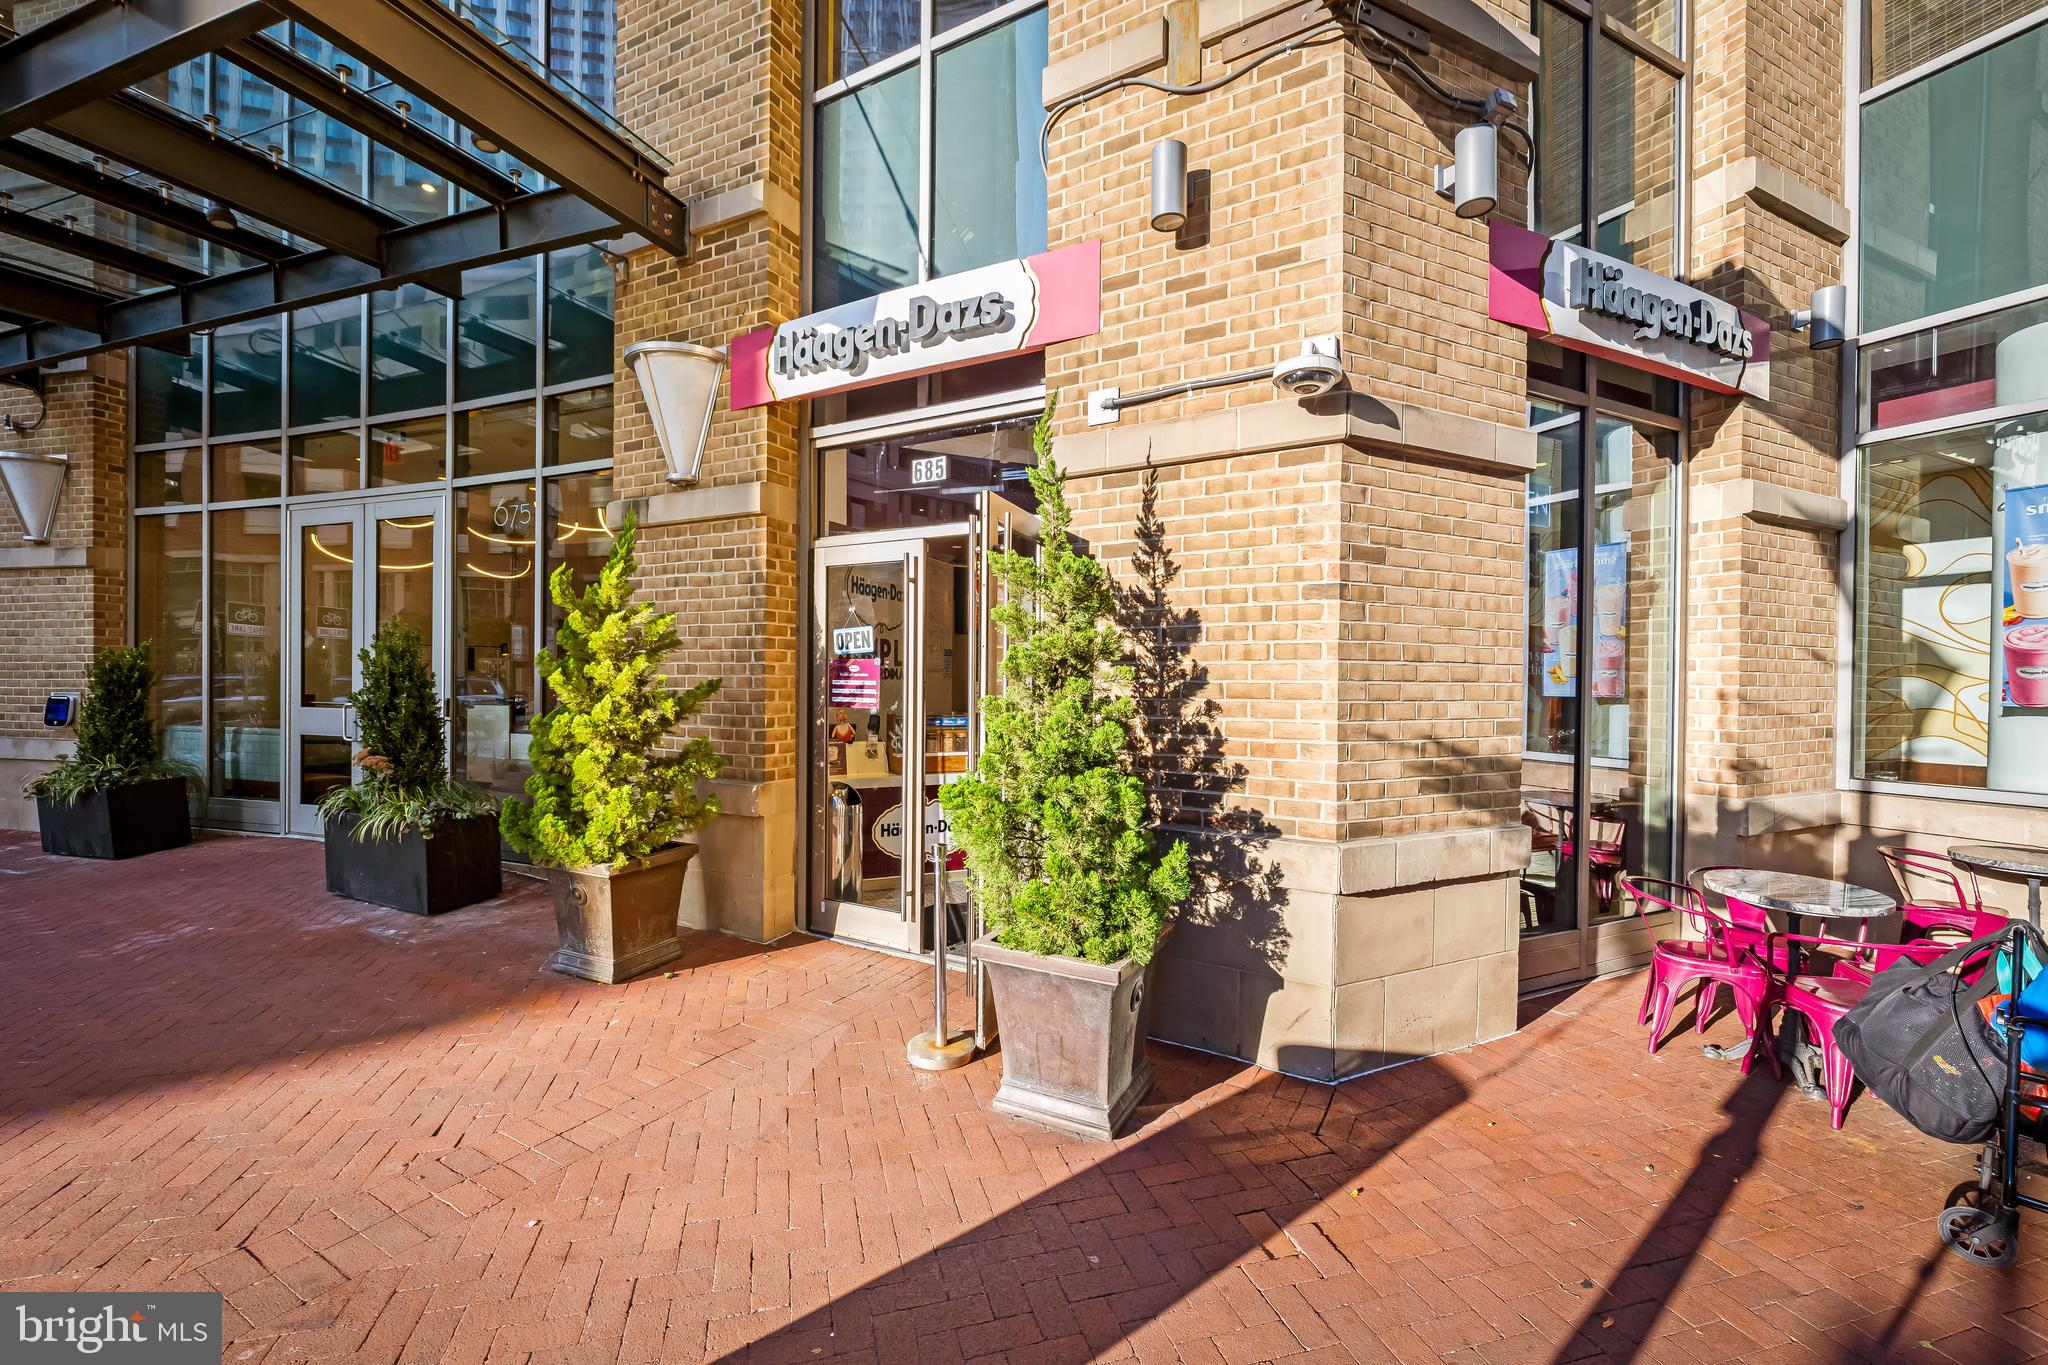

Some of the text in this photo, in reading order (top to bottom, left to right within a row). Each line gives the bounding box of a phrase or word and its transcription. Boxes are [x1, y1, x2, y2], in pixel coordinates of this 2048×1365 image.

[1571, 257, 1753, 360] Häagen-Dazs
[773, 291, 1011, 374] Häagen-Dazs
[914, 457, 945, 482] 685
[494, 498, 531, 528] 675
[851, 575, 903, 602] Häagen-Da
[835, 630, 871, 651] OPEN
